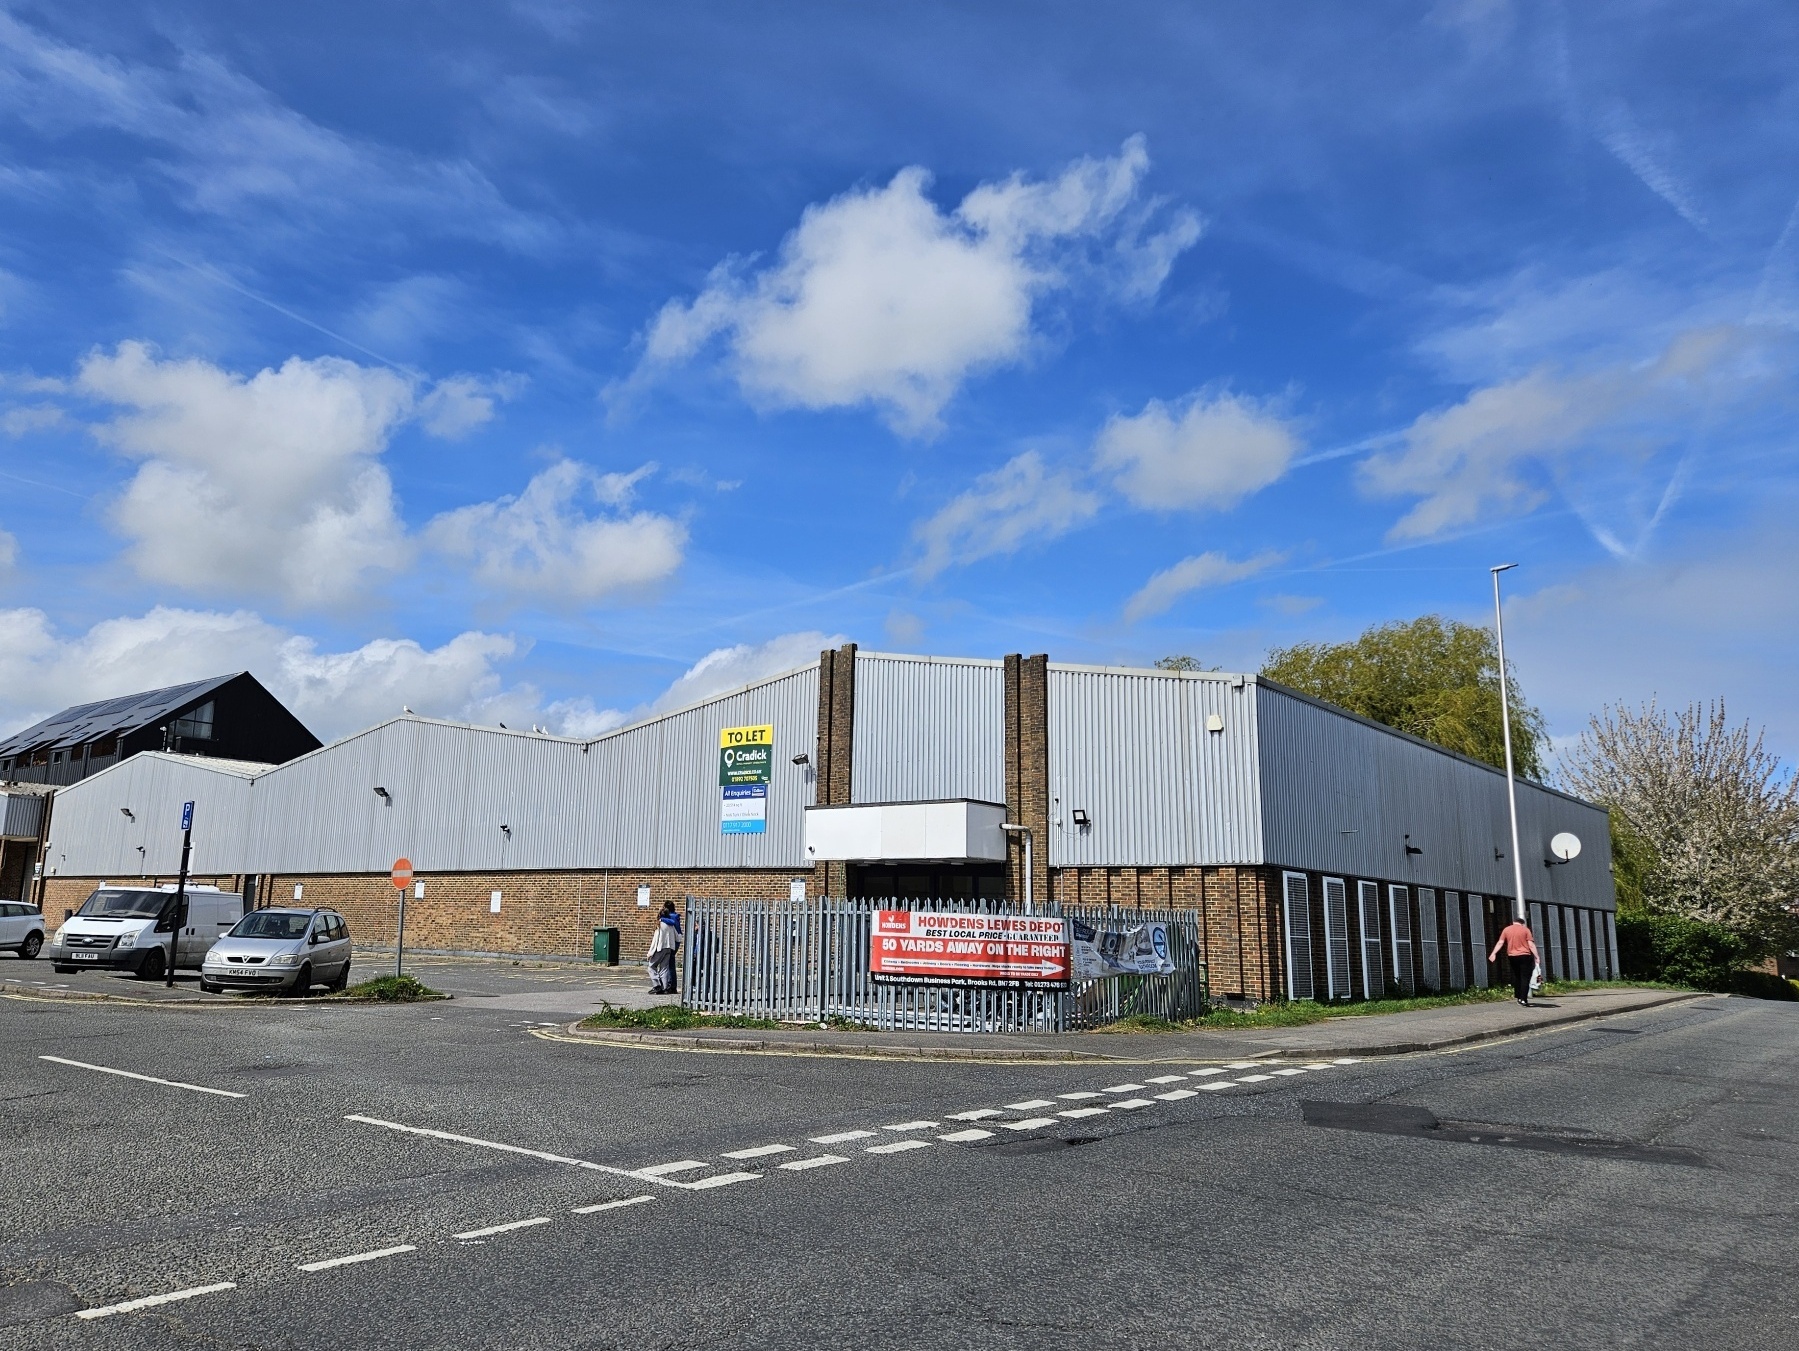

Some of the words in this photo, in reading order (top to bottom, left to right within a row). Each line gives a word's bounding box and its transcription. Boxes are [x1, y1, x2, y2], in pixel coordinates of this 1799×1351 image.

[728, 732, 743, 743] TO
[746, 730, 766, 742] LET
[736, 749, 767, 761] Cradick
[731, 789, 751, 797] Enquiries
[184, 803, 191, 816] P
[918, 916, 985, 930] HOWDENS
[987, 919, 1027, 932] LEWES
[1029, 921, 1065, 933] DEPOT
[925, 929, 948, 937] BEST
[948, 930, 976, 938] LOCAL
[978, 931, 1003, 940] PRICE
[1007, 933, 1059, 942] GUARANTEED
[882, 938, 897, 951] 50
[900, 939, 944, 953] YARDS
[946, 941, 984, 955] AWAY
[986, 943, 1004, 956] ON
[1006, 943, 1029, 956] THE
[1031, 944, 1066, 958] RIGHT
[890, 975, 923, 983] Southdown
[923, 976, 951, 984] Business
[951, 978, 967, 986] Park,
